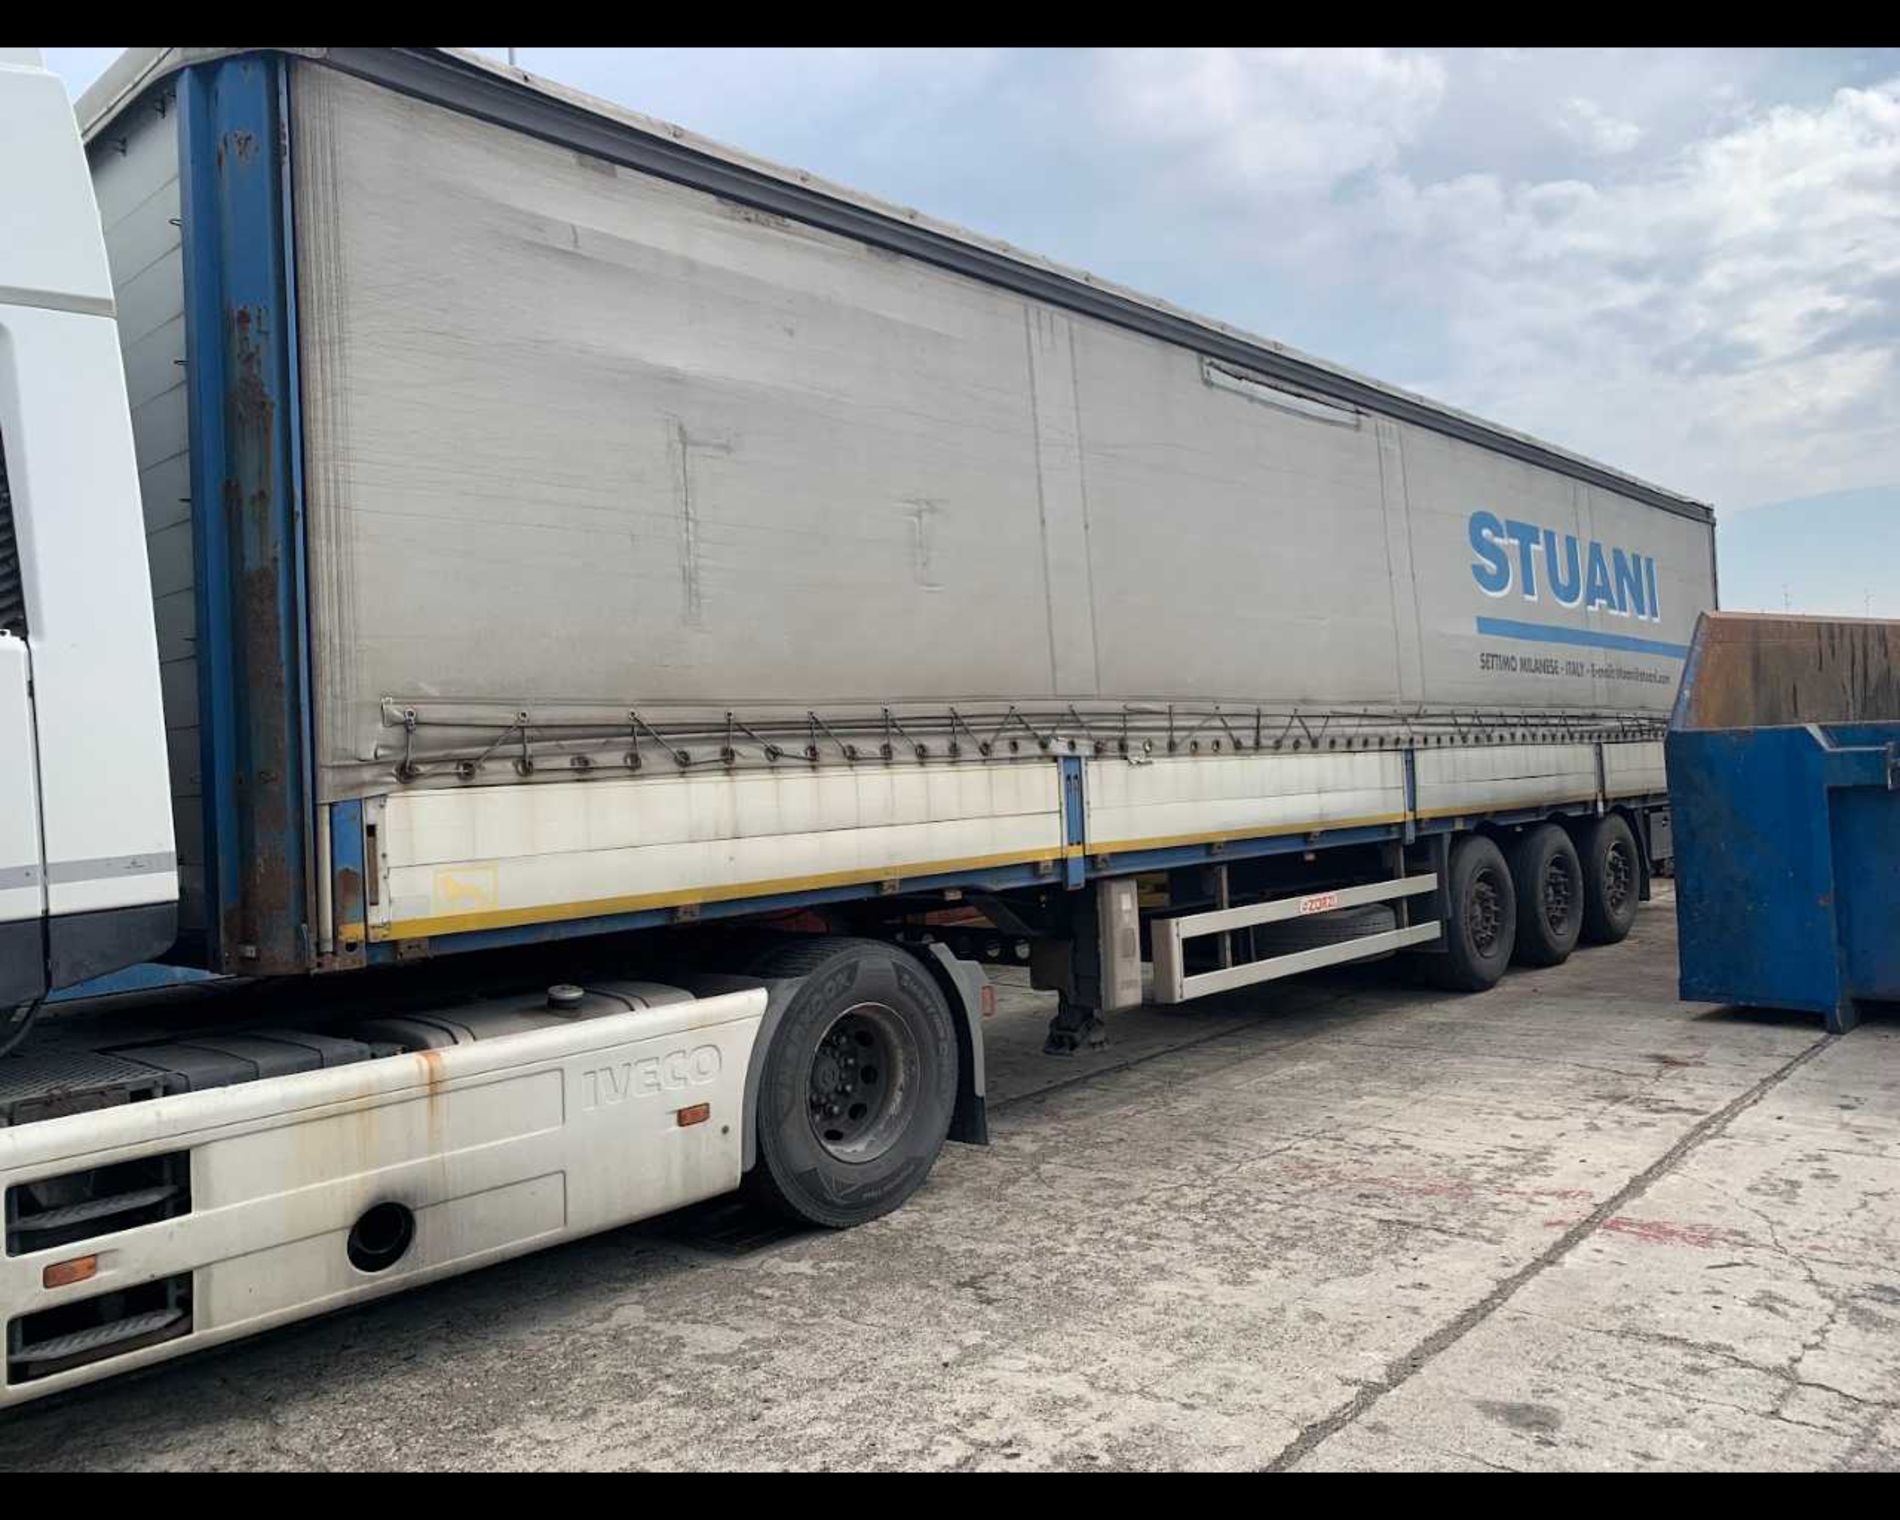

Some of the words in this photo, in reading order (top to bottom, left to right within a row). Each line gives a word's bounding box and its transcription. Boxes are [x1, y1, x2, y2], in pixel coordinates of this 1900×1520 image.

[1468, 509, 1660, 623] STUANI
[1479, 652, 1518, 672] SETTIMO
[582, 1044, 722, 1111] IVECO
